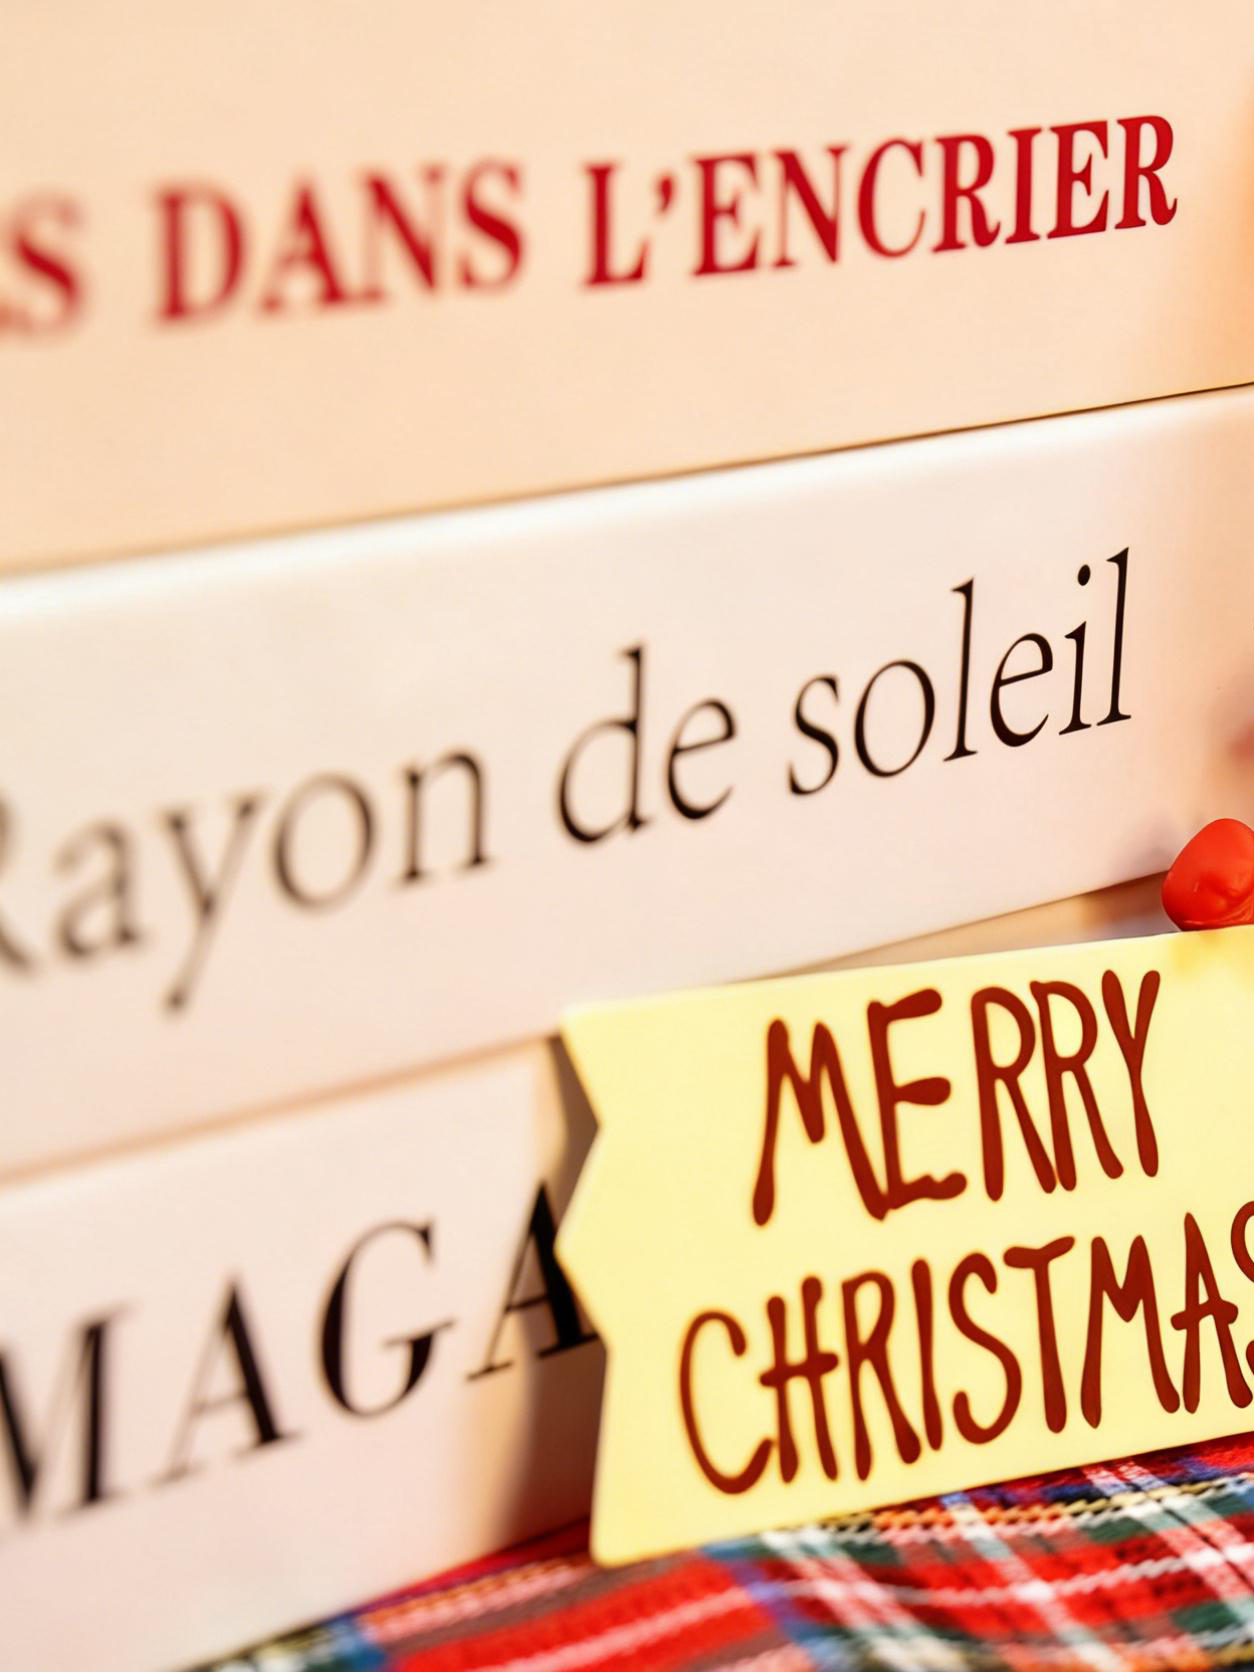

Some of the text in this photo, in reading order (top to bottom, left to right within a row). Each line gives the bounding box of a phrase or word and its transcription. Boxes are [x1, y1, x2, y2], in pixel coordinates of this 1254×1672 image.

[0, 184, 86, 346] S
[153, 156, 526, 332] DANS
[556, 640, 738, 845] de
[788, 546, 1132, 797] soleil
[752, 969, 1161, 1227] MERRY
